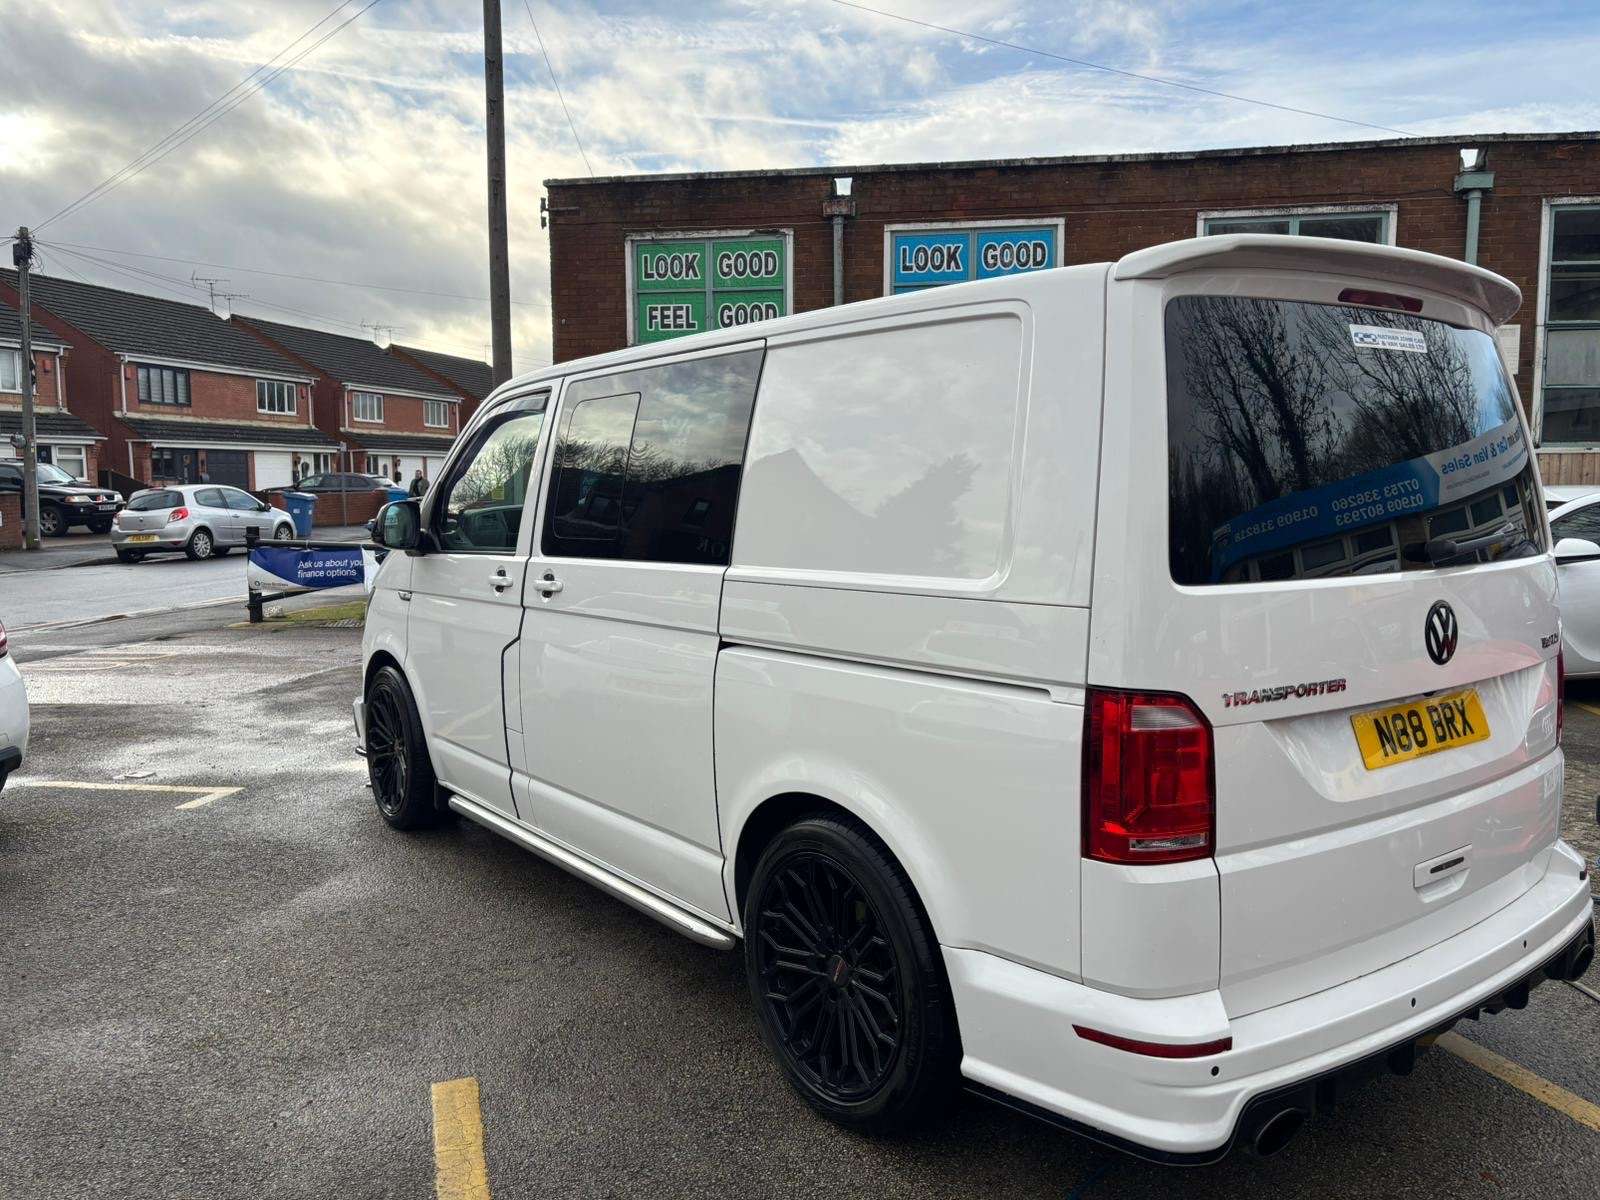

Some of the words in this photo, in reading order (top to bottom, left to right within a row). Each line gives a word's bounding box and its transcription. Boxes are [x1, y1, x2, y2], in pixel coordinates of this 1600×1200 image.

[642, 253, 701, 280] LOOK
[718, 250, 778, 279] GOOD
[900, 244, 963, 273] LOOK
[982, 240, 1047, 271] GOOD
[647, 304, 698, 331] FEEL
[718, 302, 779, 329] GOOD
[298, 560, 313, 569] Ask
[325, 559, 348, 568] about
[298, 569, 325, 578] finance
[326, 568, 357, 578] options
[1222, 678, 1347, 708] TRANSPORTER
[1374, 709, 1428, 757] N88
[1426, 698, 1474, 744] BRX
